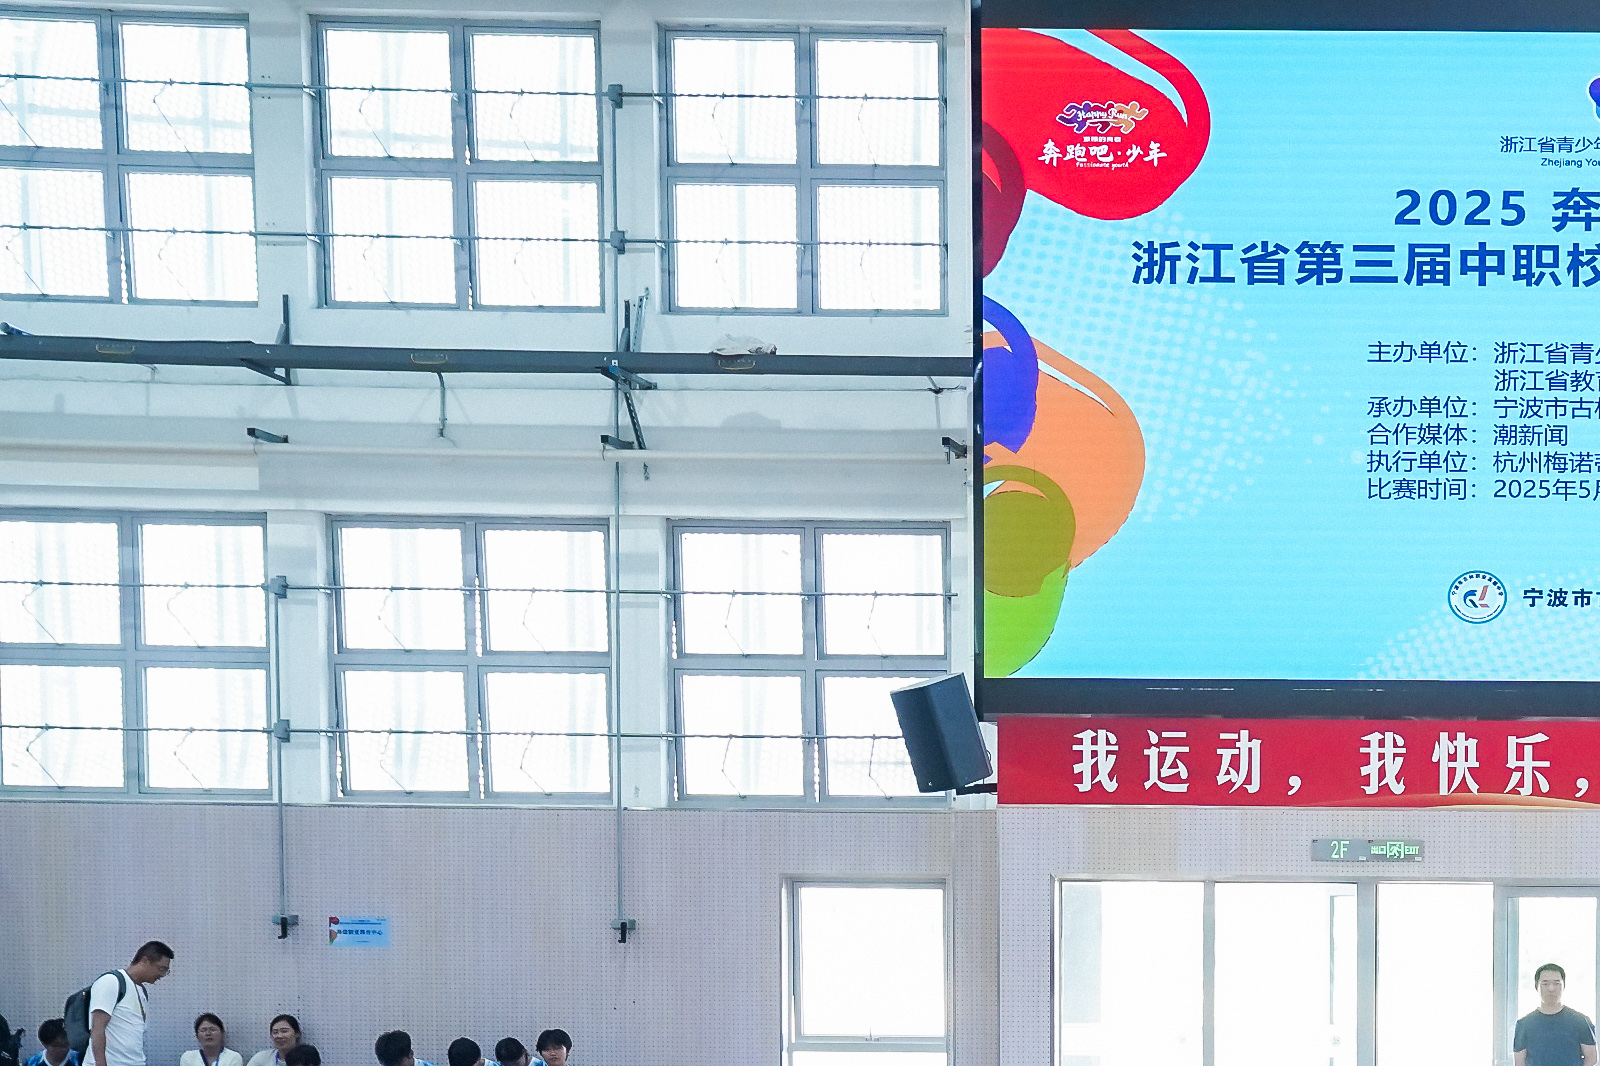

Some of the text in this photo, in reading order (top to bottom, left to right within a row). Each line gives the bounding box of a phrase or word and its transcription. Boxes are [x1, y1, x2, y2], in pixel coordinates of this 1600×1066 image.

[1541, 158, 1583, 168] Zhejiang
[1394, 188, 1528, 227] 2025
[1330, 840, 1350, 859] 2F
[1370, 845, 1420, 855] 出口 EXIT
